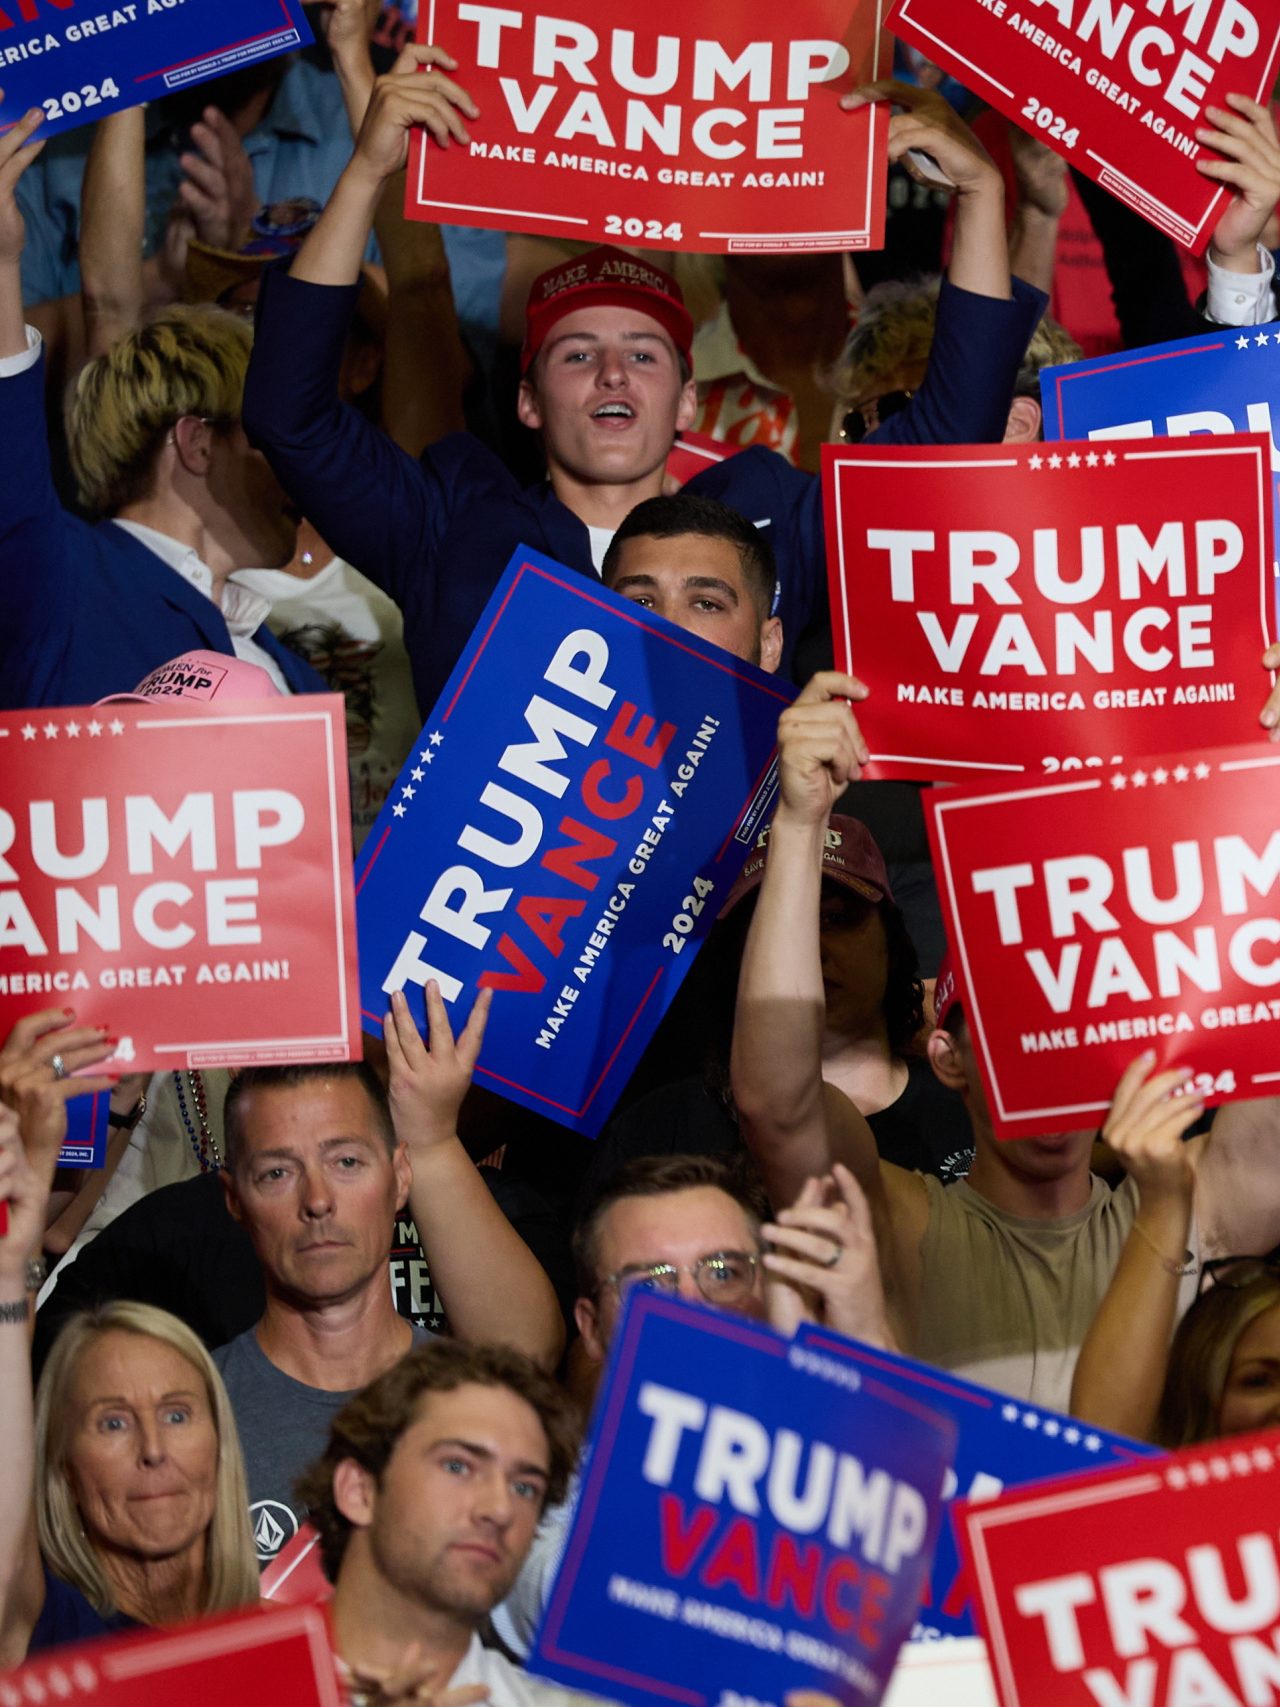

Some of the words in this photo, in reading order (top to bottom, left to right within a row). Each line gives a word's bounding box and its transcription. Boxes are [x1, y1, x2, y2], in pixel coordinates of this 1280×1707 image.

[65, 4, 138, 42] GREAT
[458, 3, 852, 103] TRUMP
[42, 77, 120, 121] 2024
[1006, 12, 1082, 76] AMERICA
[1085, 67, 1141, 116] GREAT
[1139, 109, 1200, 160] AGAIN!
[498, 76, 805, 160] VANCE
[1021, 97, 1080, 149] 2024
[469, 141, 537, 164] MAKE
[543, 151, 650, 182] AMERICA
[657, 168, 735, 187] GREAT
[742, 171, 826, 189] AGAIN!
[604, 214, 683, 242] 2024
[543, 264, 588, 298] MAKE
[600, 260, 669, 295] AMERICA
[867, 519, 1244, 605] TRUMP
[917, 605, 1215, 676] VANCE
[143, 686, 184, 697] 2024
[193, 667, 212, 676] for
[897, 683, 964, 707] MAKE
[972, 688, 1085, 711] AMERICA
[1094, 688, 1165, 708] GREAT
[1173, 683, 1235, 705] AGAIN!
[381, 628, 617, 1004] TRUMP
[477, 699, 678, 994] VANCE
[744, 859, 765, 877] SAVE
[823, 852, 846, 866] GAIN
[534, 982, 580, 1050] MAKE
[578, 879, 636, 984] AMERICA
[628, 799, 676, 877] GREAT
[673, 713, 722, 799] AGAIN!
[662, 875, 716, 955] 2024
[100, 966, 187, 989] GREAT
[195, 959, 290, 983] AGAIN!
[1020, 1027, 1079, 1054] MAKE
[1084, 1013, 1194, 1047] AMERICA
[1174, 1069, 1237, 1096] 24
[637, 1382, 927, 1575] TRUMP
[660, 1492, 890, 1650] VANCE
